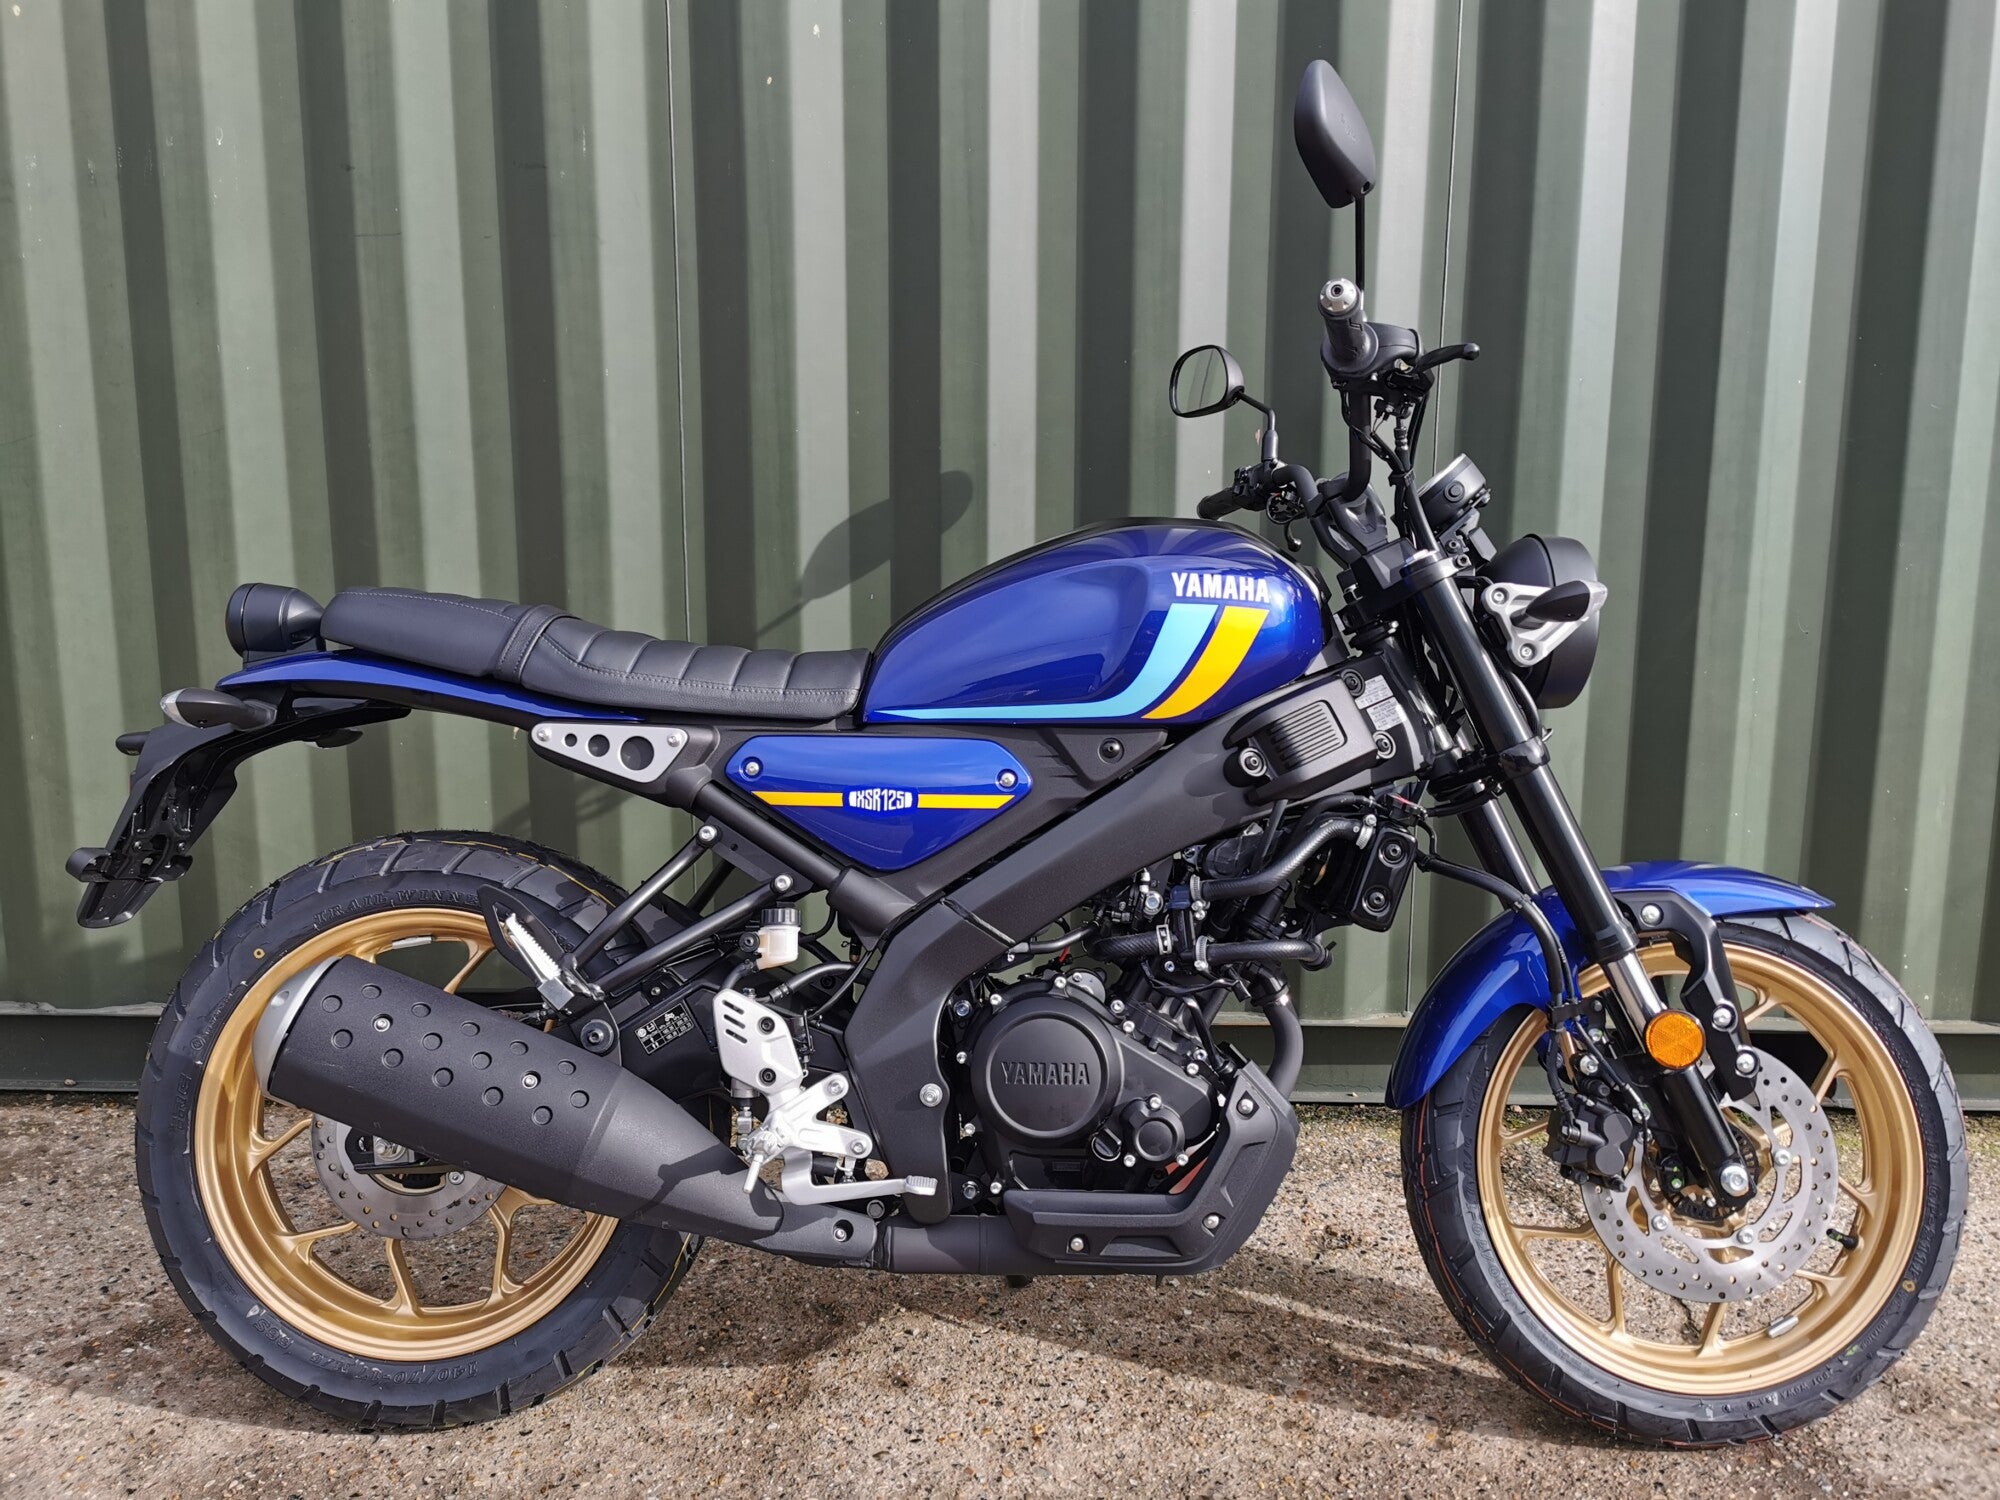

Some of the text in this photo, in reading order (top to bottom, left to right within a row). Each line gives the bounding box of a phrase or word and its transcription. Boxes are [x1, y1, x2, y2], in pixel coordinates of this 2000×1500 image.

[1171, 571, 1270, 603] YAMAHA
[857, 787, 905, 812] XSR125
[312, 888, 479, 924] TRAIL WINNE
[1002, 1062, 1090, 1086] YAMAHA
[355, 1360, 479, 1384] 140/70-17
